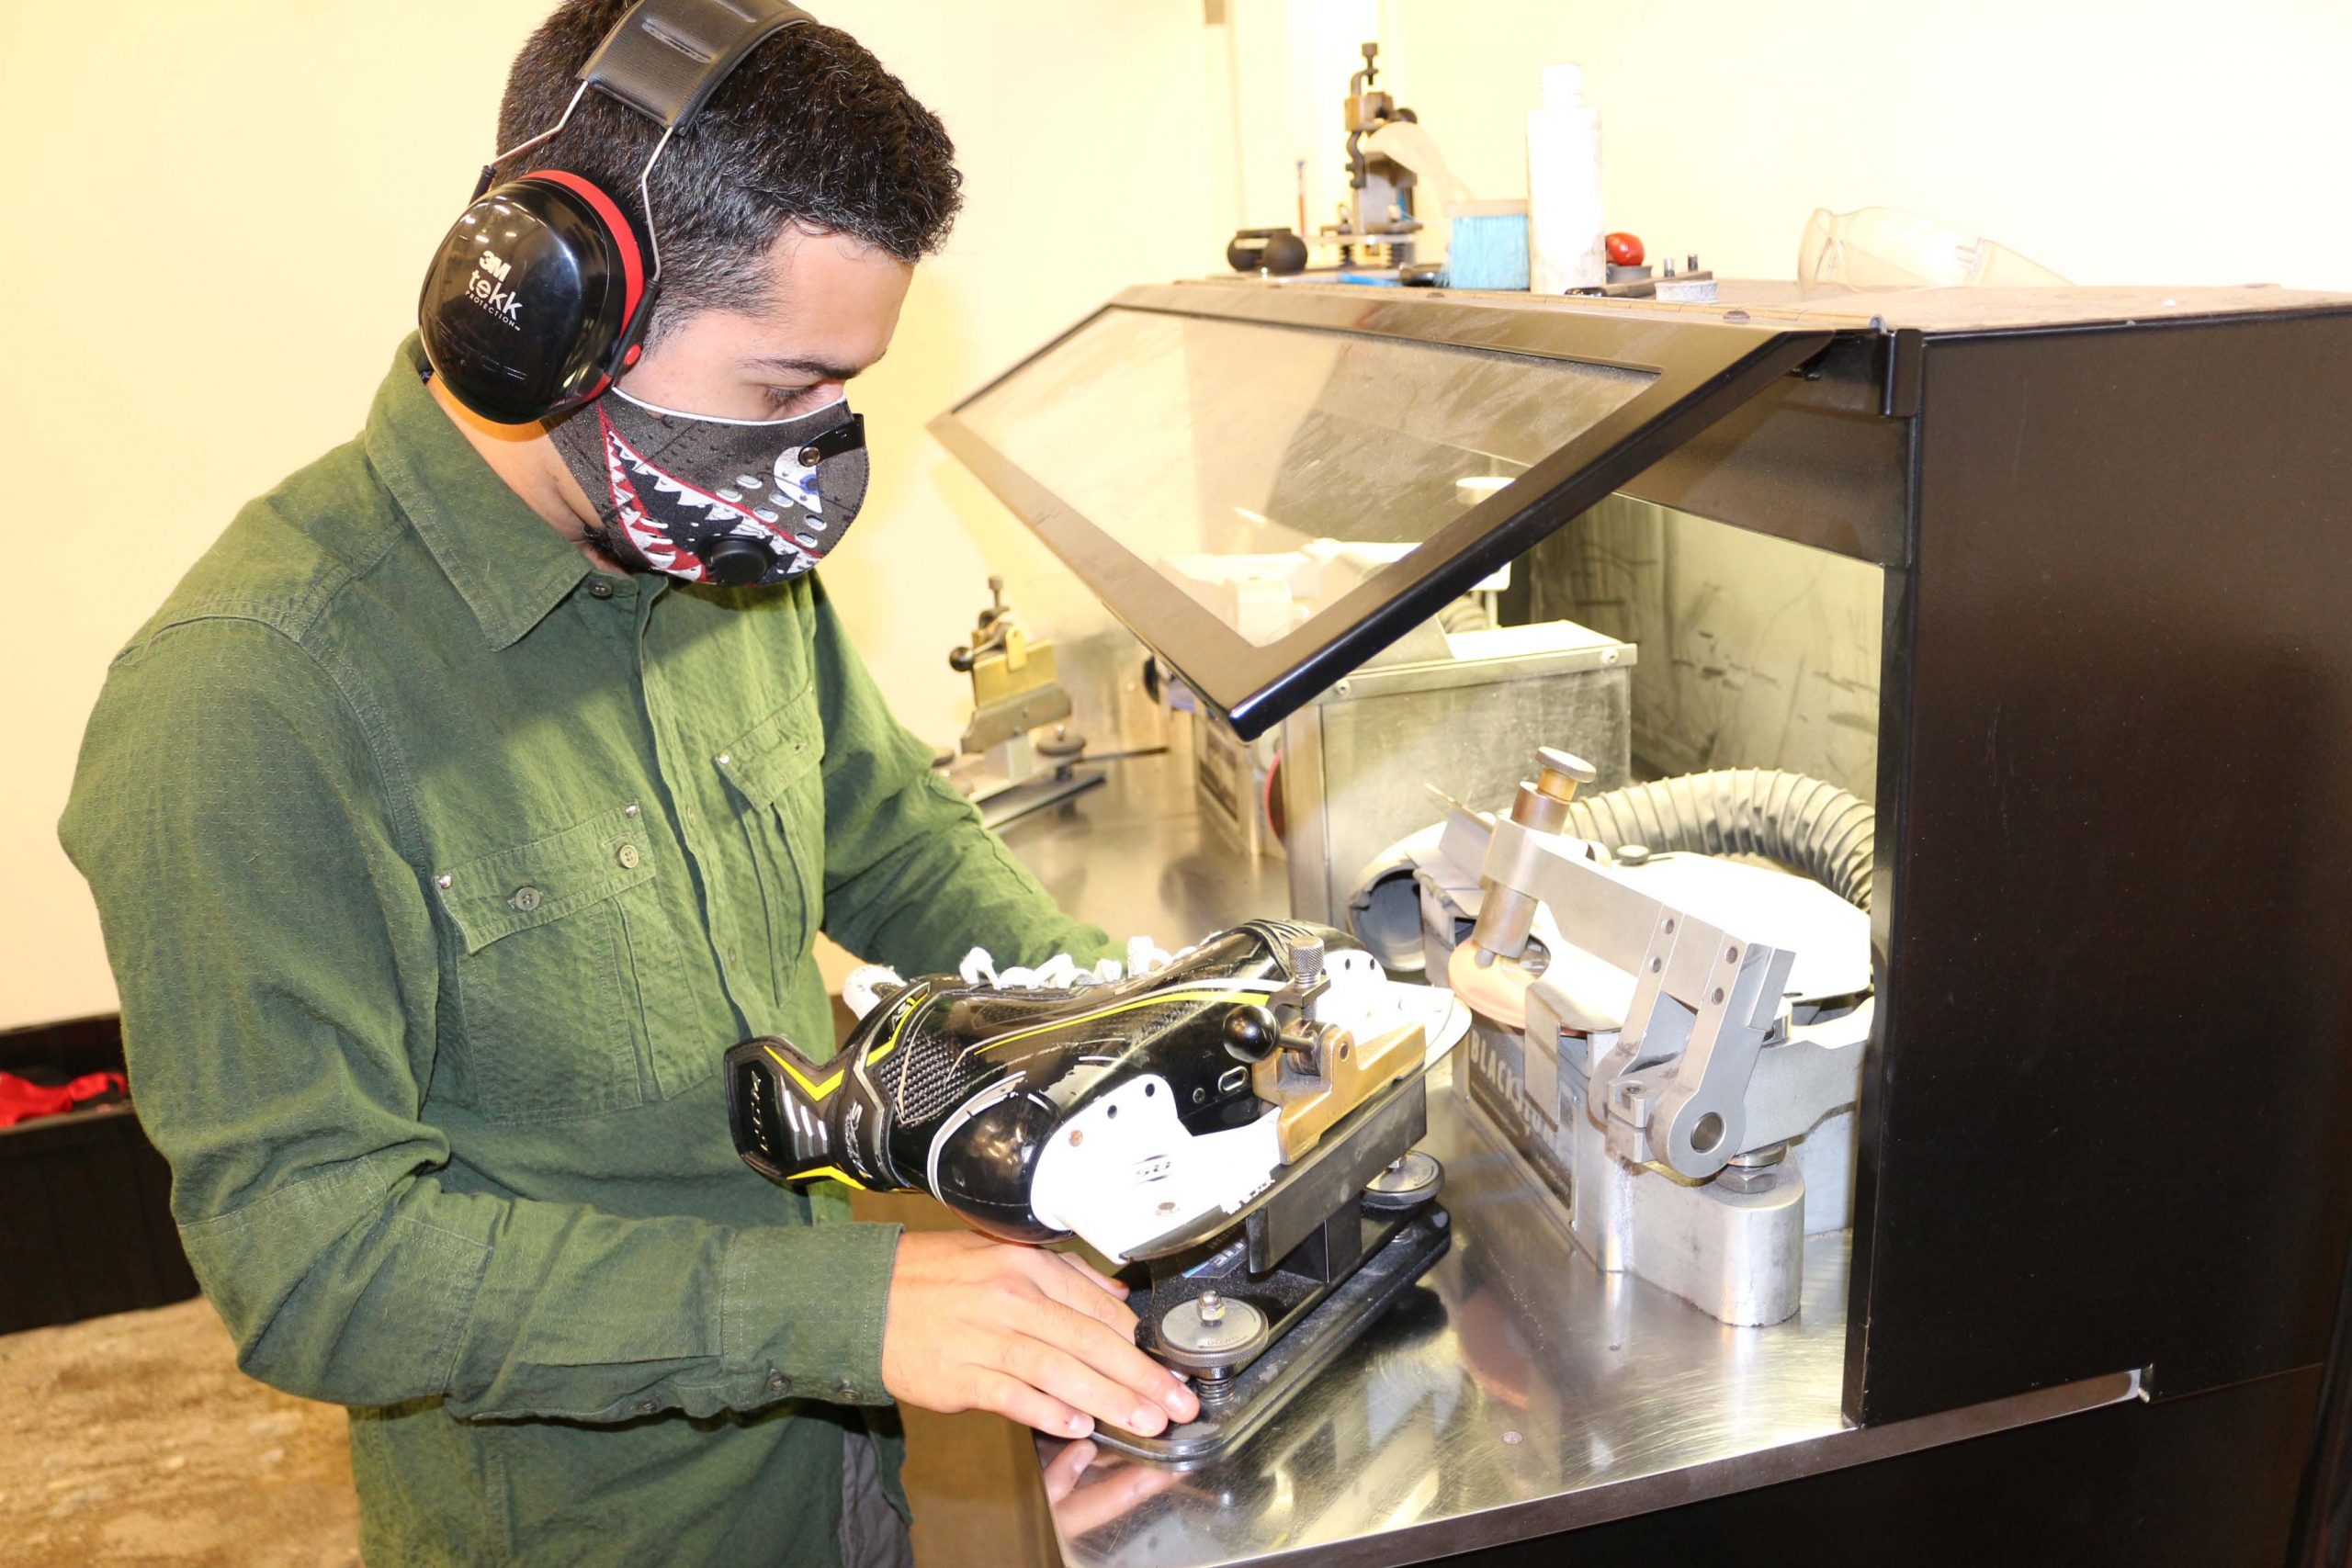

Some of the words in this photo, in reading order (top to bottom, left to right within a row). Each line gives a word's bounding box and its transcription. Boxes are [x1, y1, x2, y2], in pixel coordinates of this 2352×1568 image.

[480, 250, 512, 282] 3M
[465, 289, 515, 327] PROTECTION
[469, 269, 523, 321] tekk
